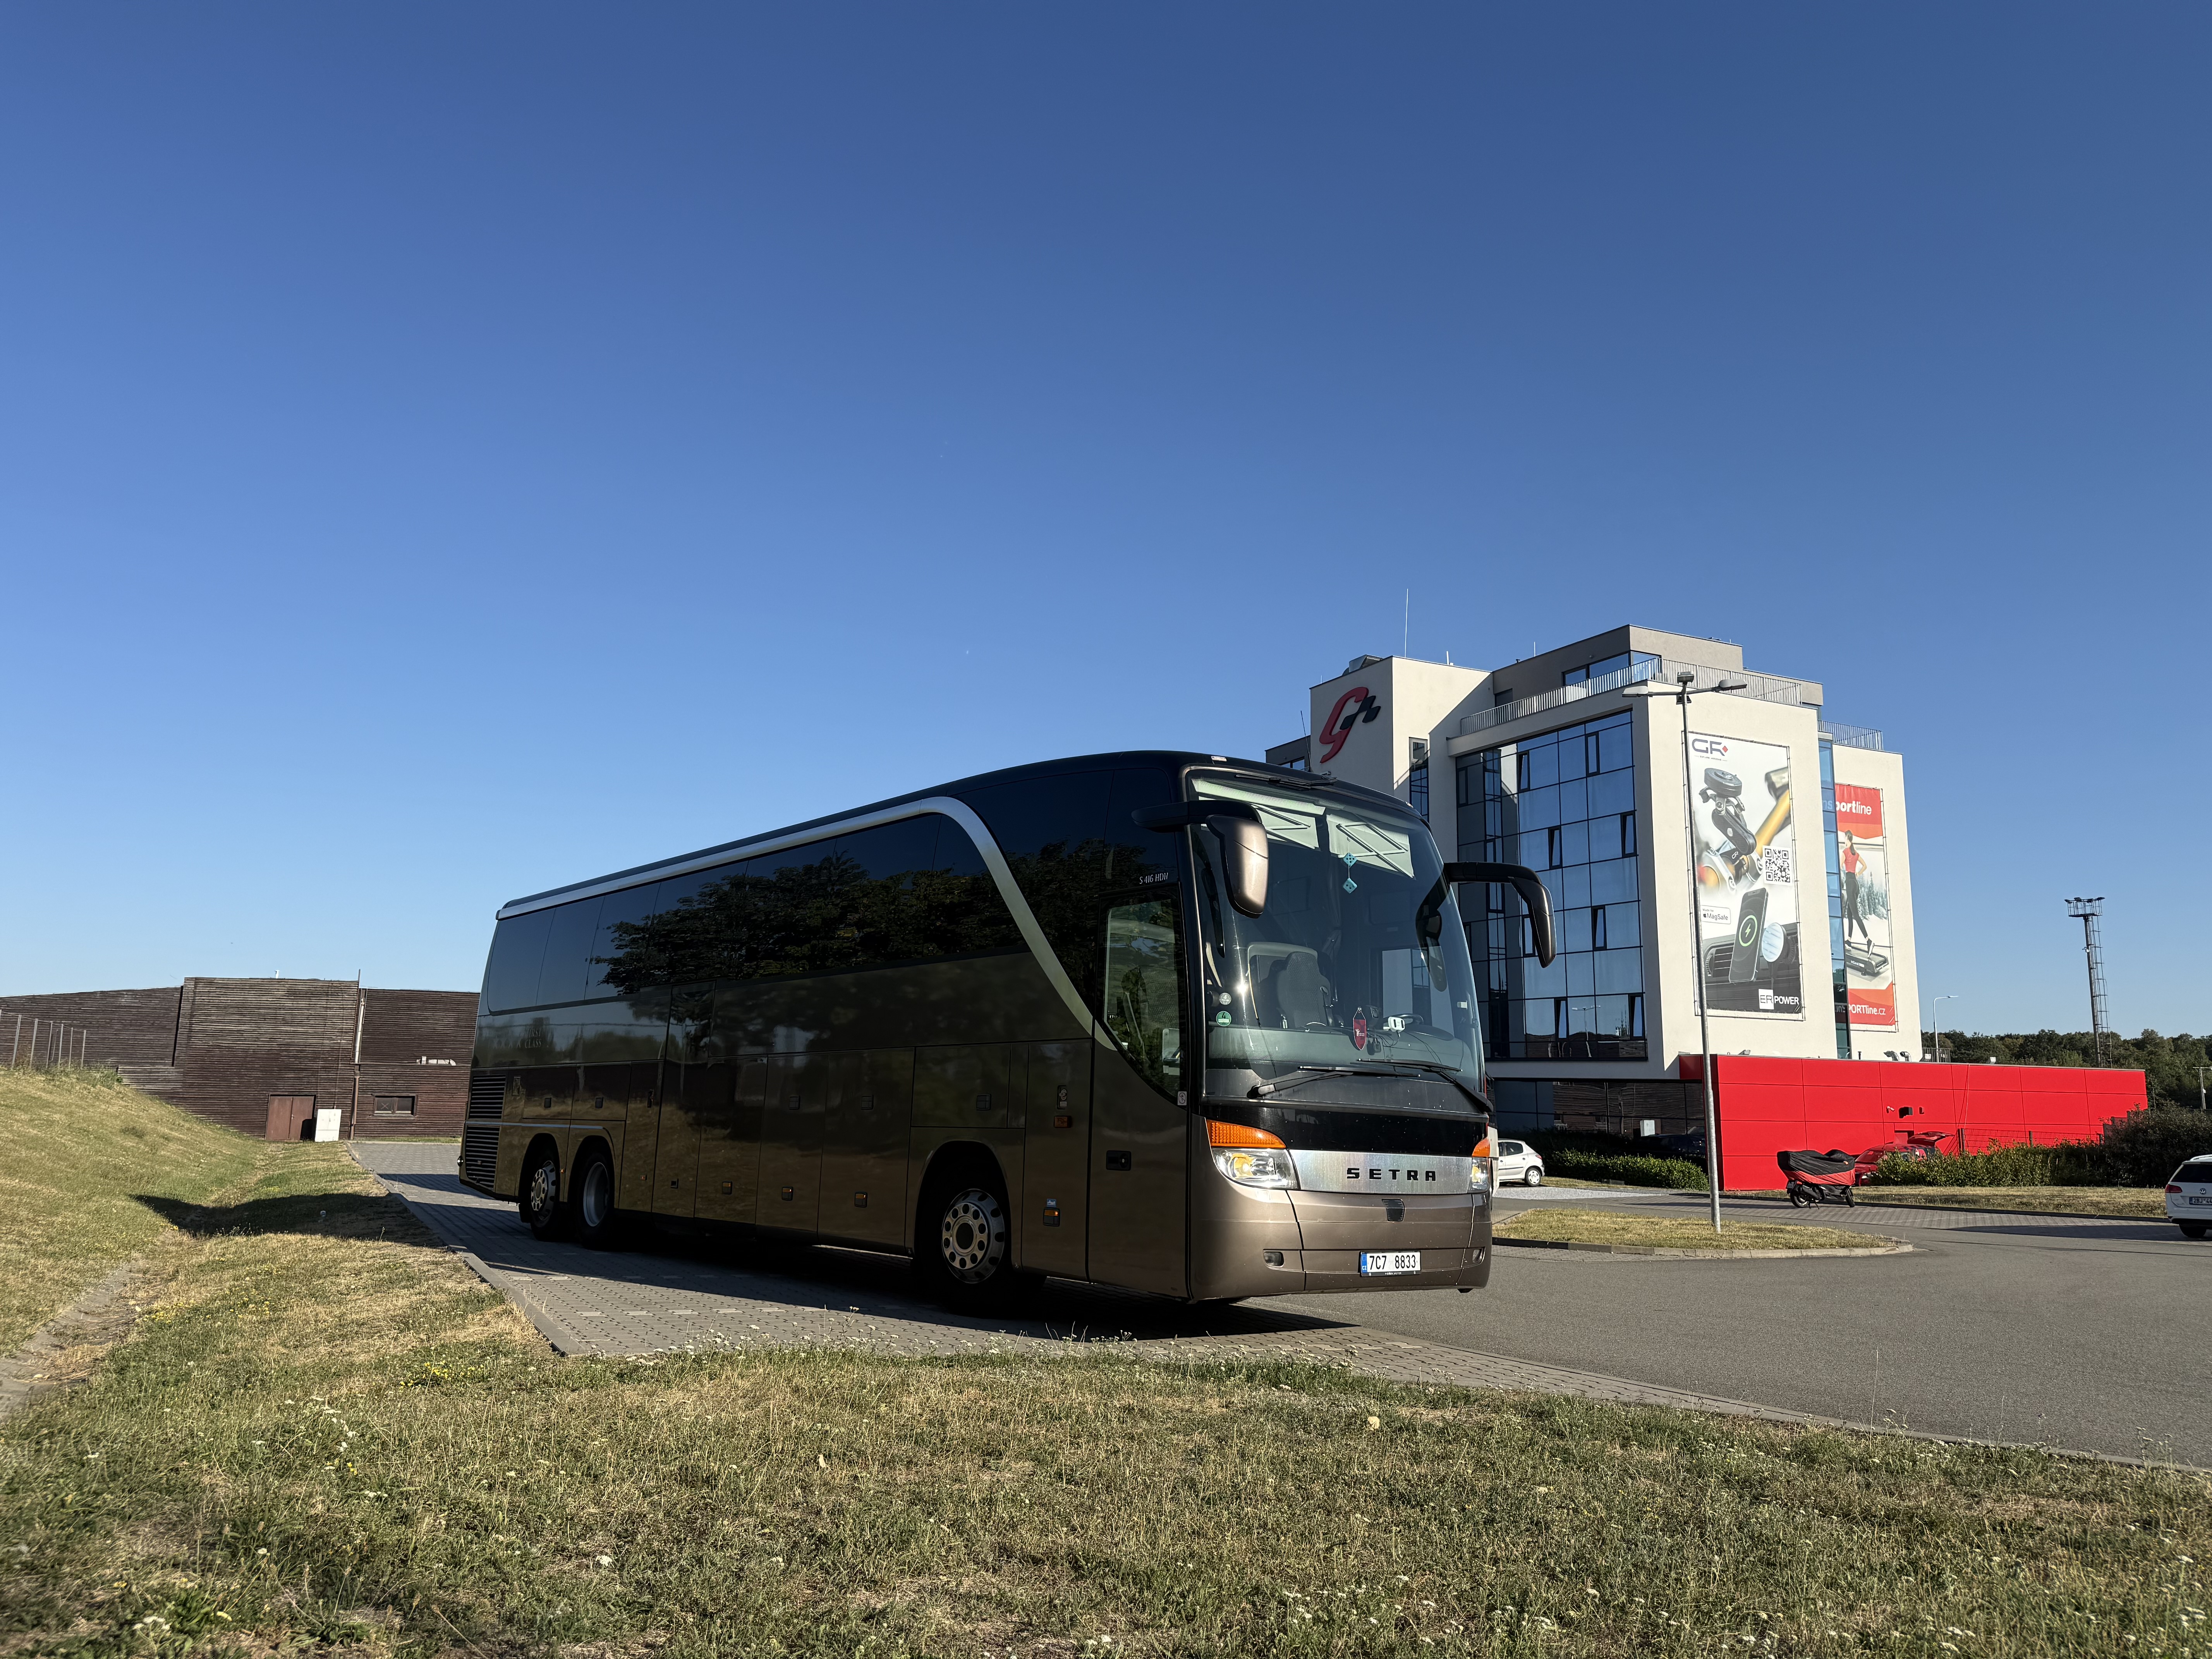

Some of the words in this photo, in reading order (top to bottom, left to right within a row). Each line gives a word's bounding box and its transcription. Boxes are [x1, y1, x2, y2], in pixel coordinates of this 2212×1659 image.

[1144, 874, 1154, 883] 416
[1155, 872, 1168, 882] HDH
[1760, 995, 1773, 1004] ER
[1774, 995, 1800, 1005] POWER
[525, 1039, 542, 1048] CLASS
[1346, 1168, 1436, 1181] SETRA
[1369, 1255, 1387, 1270] 7C7
[1395, 1254, 1416, 1269] 8833
